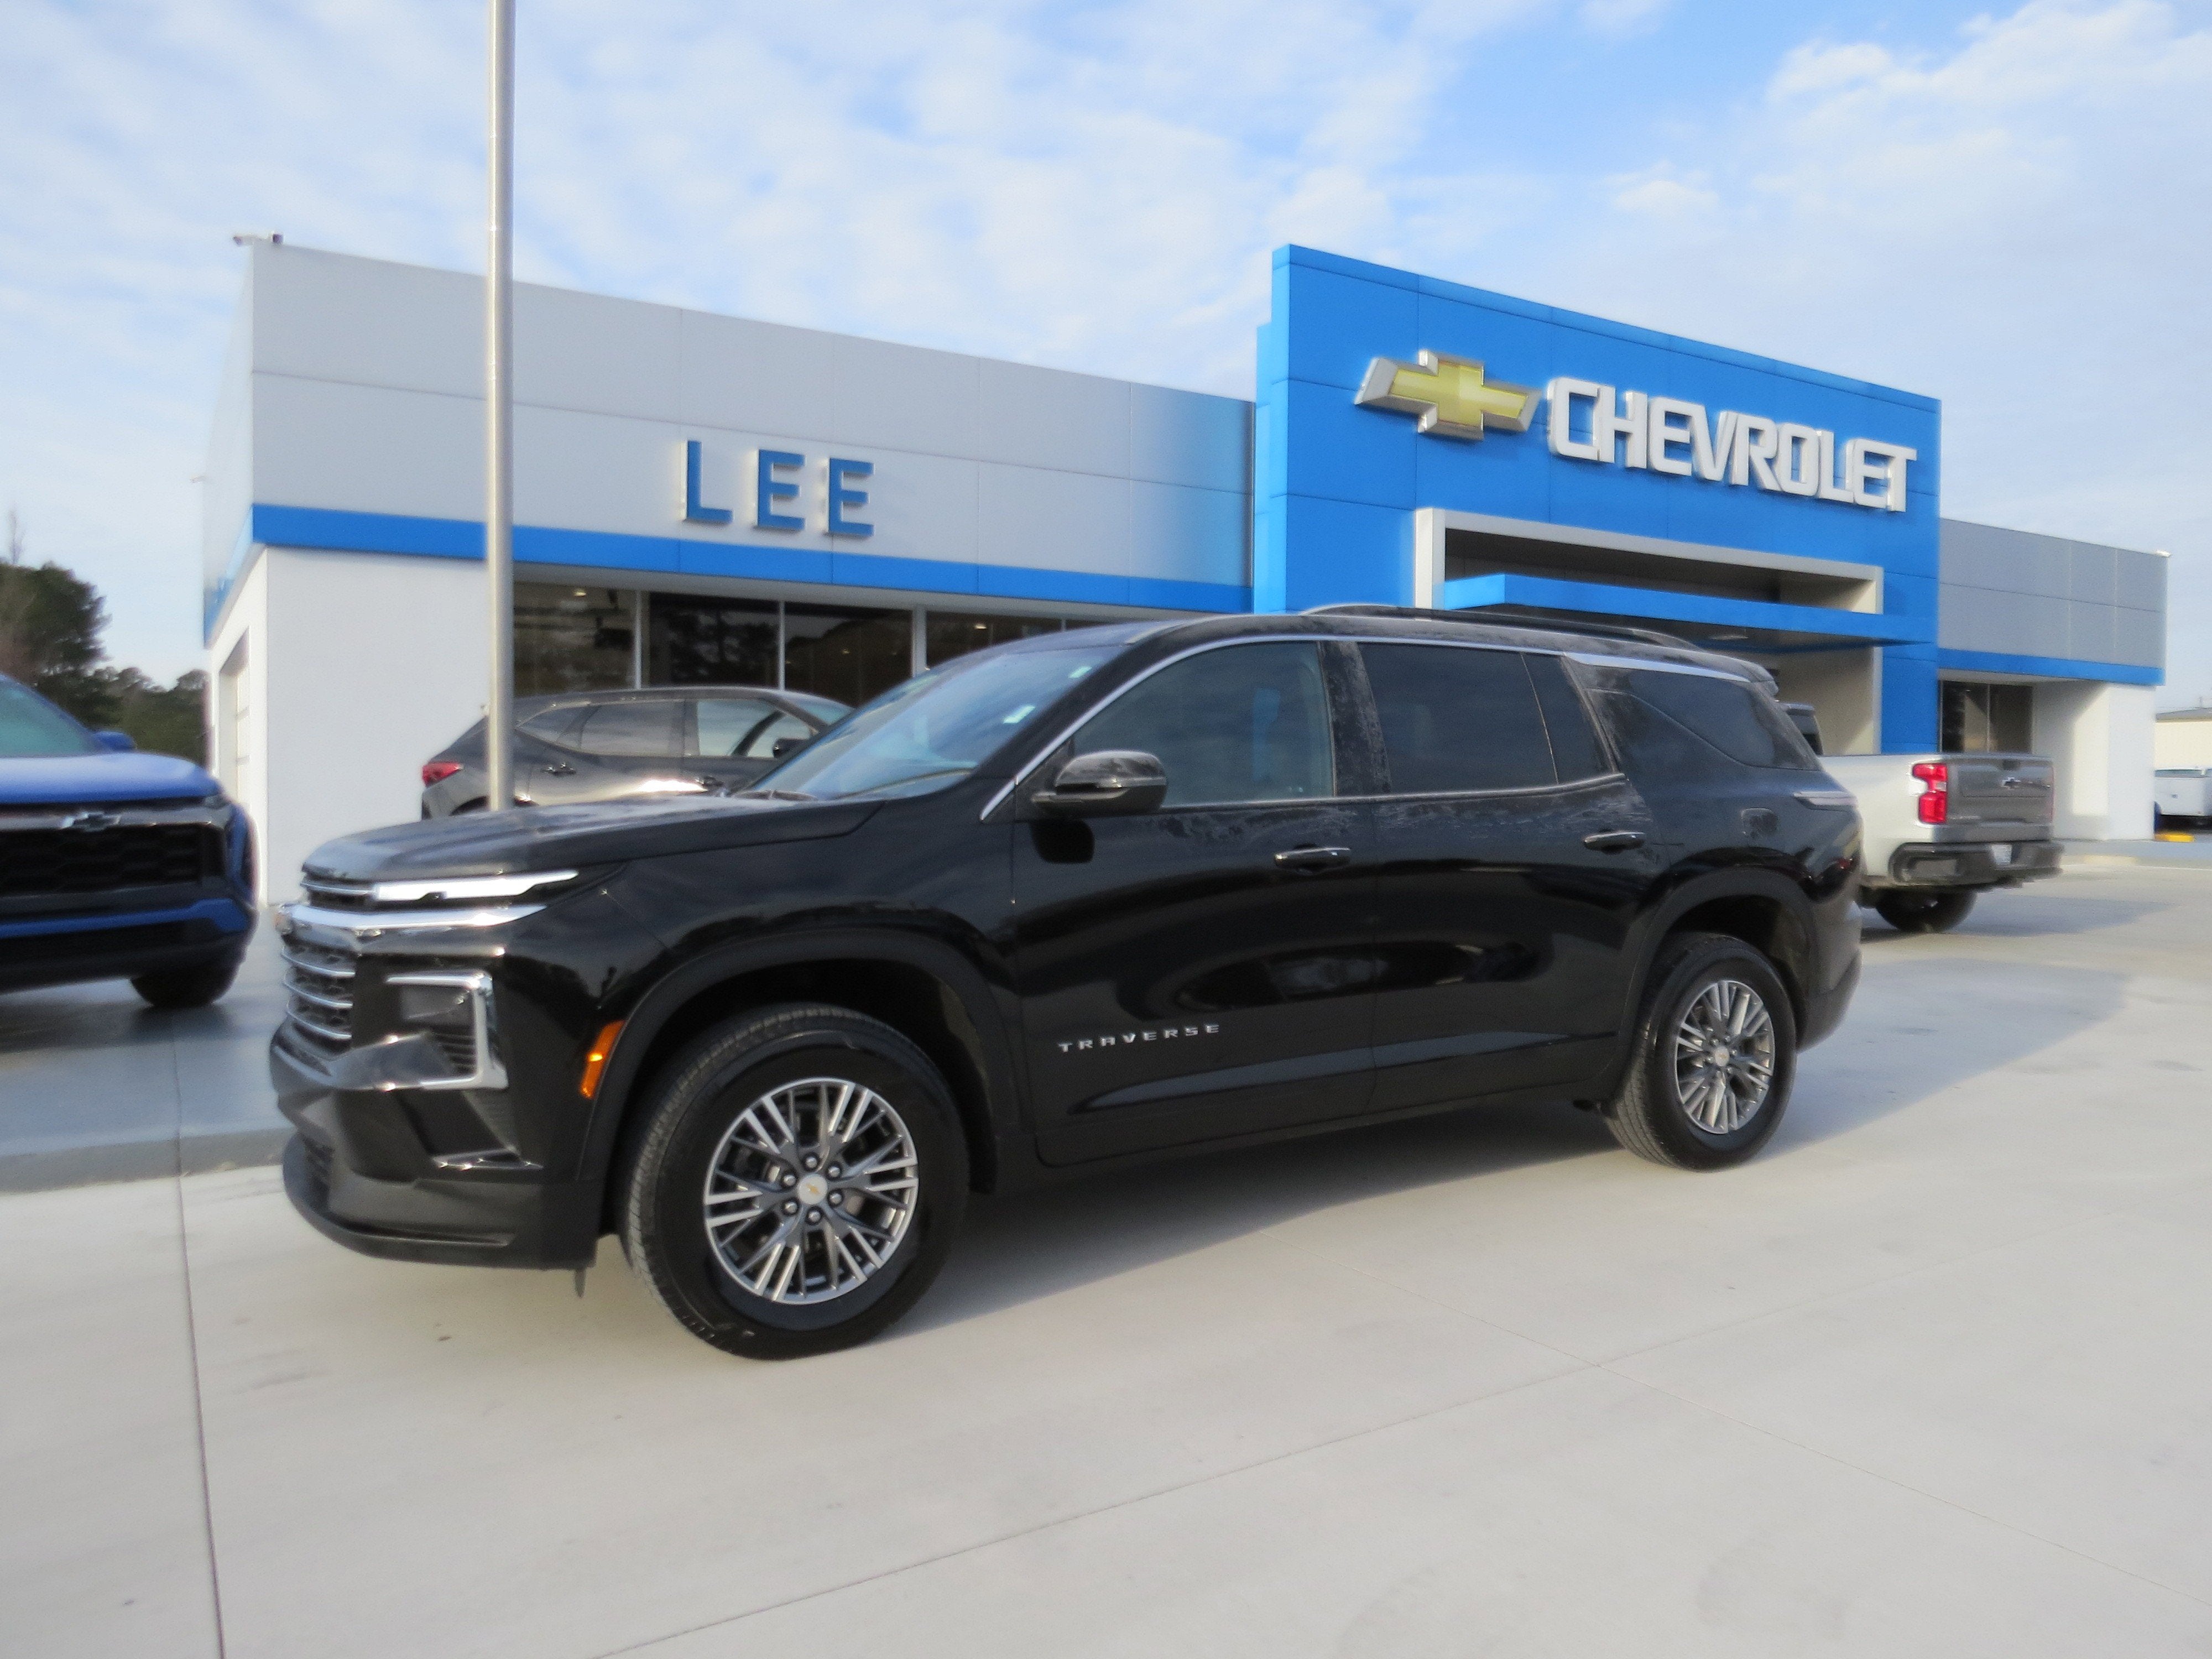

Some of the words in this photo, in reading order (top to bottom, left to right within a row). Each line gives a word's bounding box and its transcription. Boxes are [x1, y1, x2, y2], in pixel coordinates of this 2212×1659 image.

[684, 440, 875, 537] LEE
[1548, 377, 1917, 512] CHEVROLET
[1058, 1023, 1219, 1052] TRAVERSE
